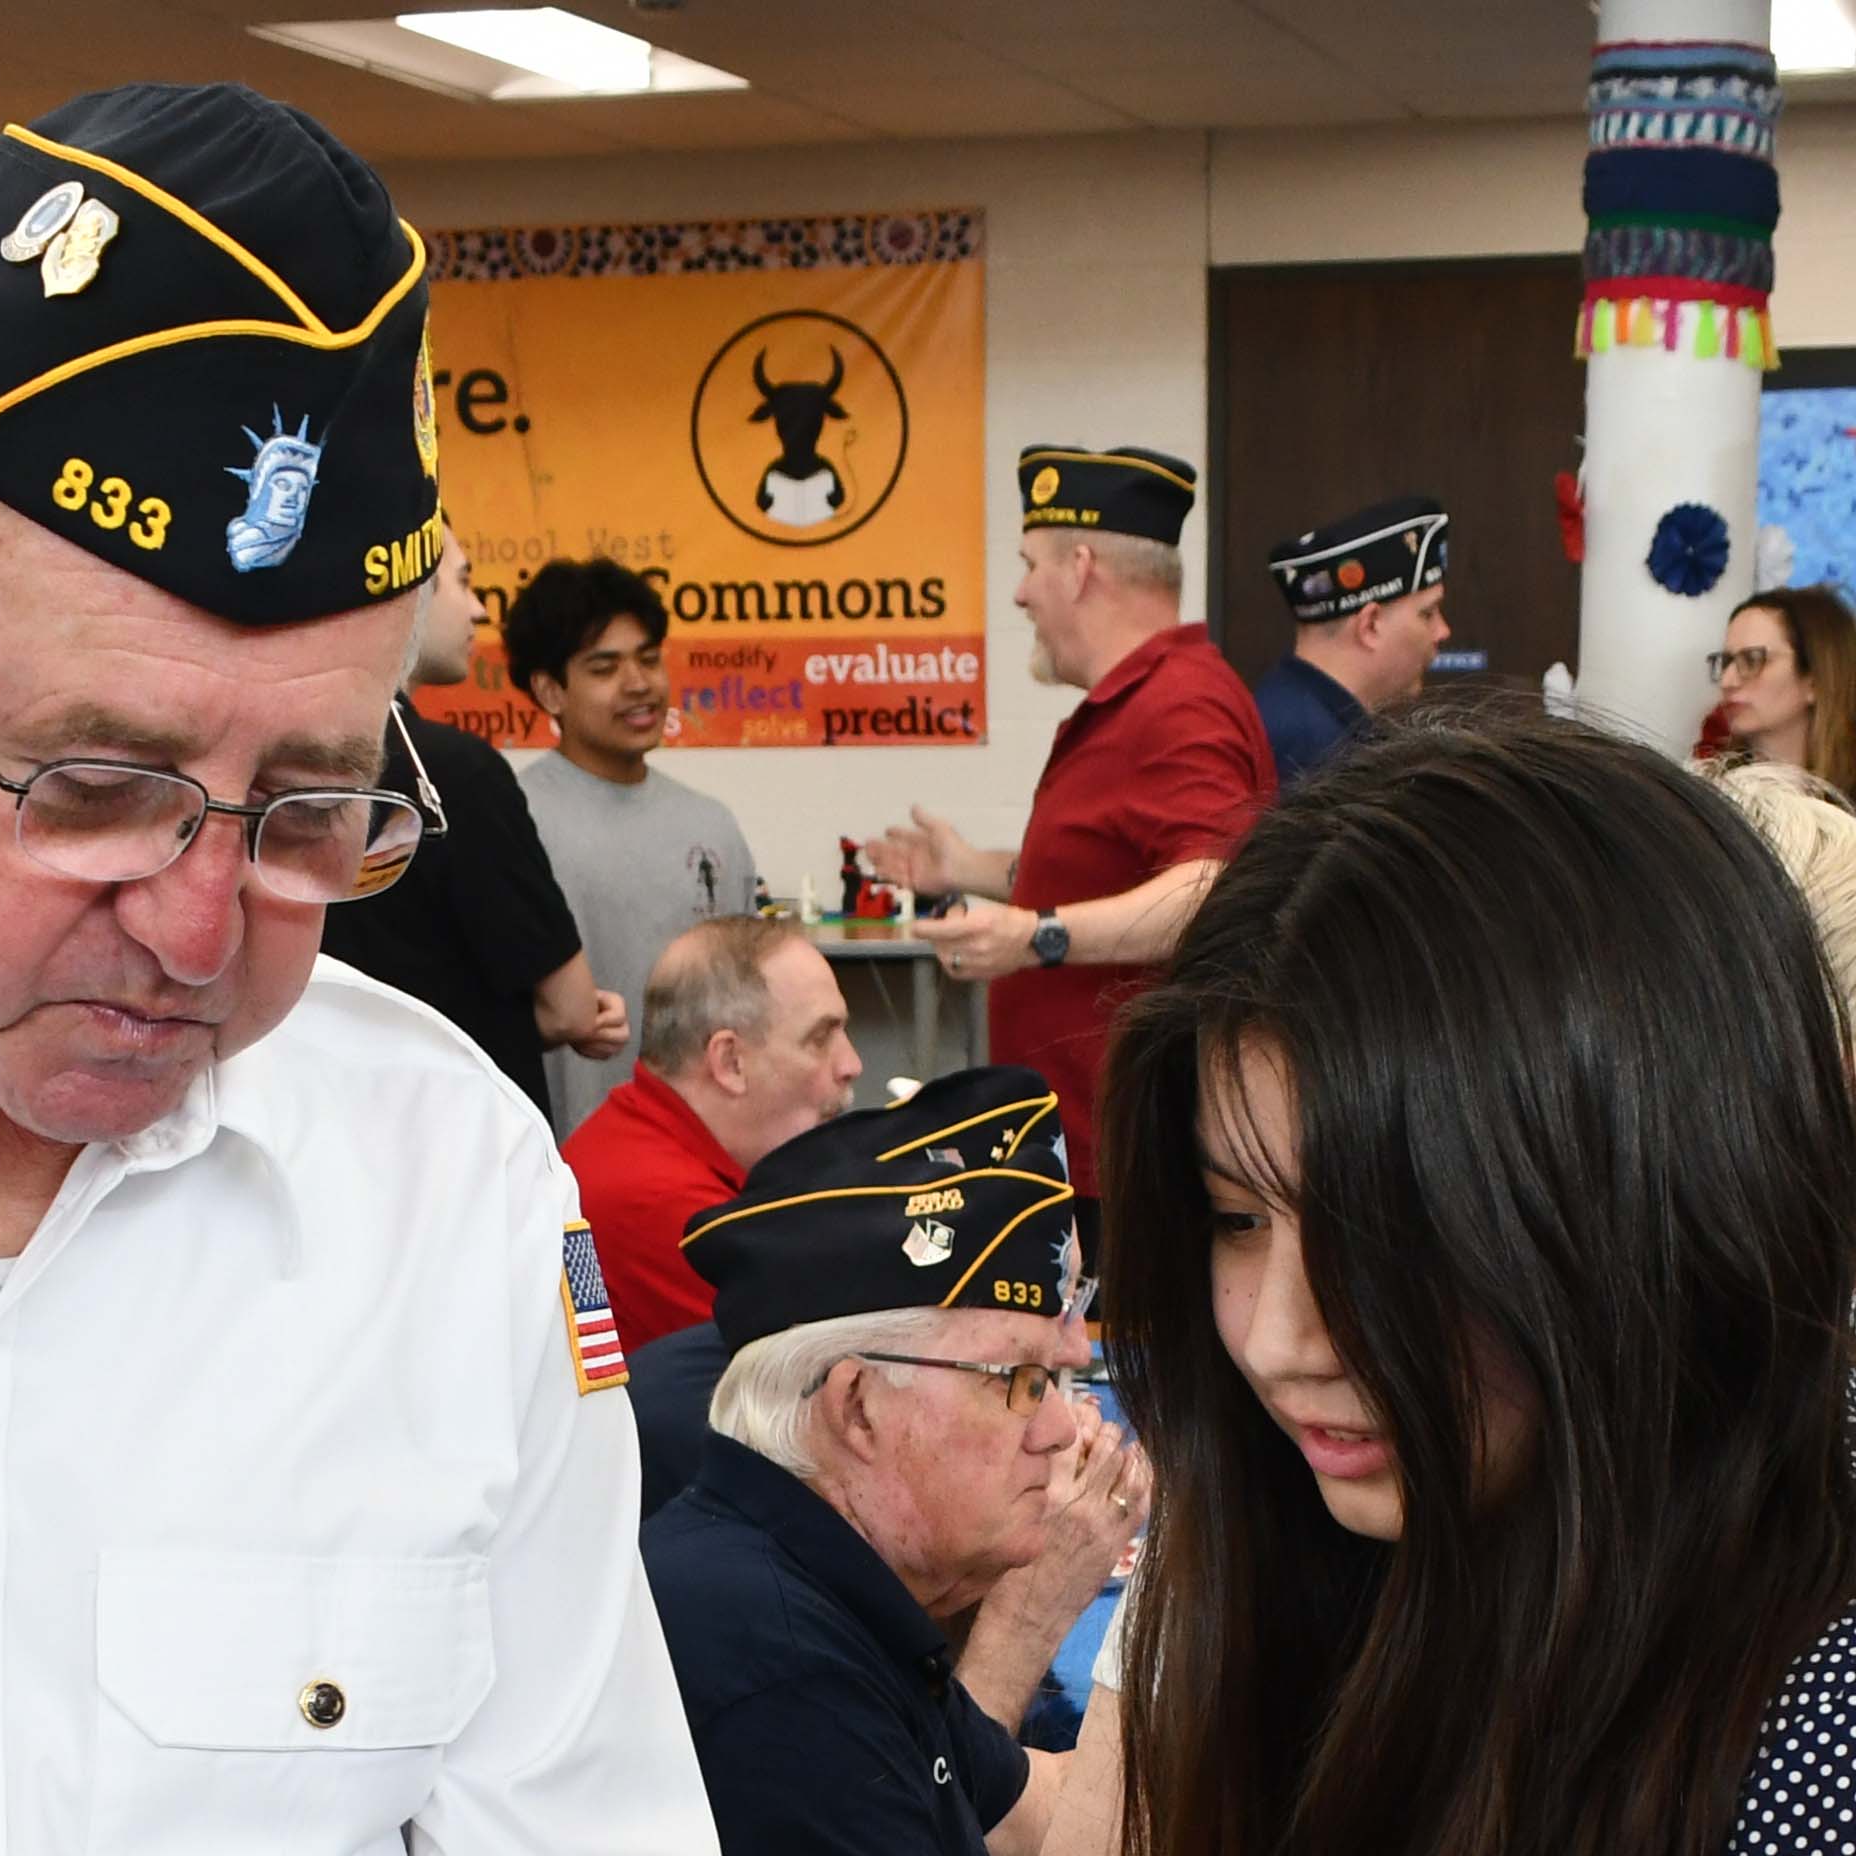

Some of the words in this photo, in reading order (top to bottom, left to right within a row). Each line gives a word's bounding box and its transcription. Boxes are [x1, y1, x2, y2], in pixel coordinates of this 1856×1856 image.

[52, 458, 172, 551] 833
[586, 527, 675, 562] West
[689, 645, 777, 672] modify
[804, 643, 979, 685] evaluate
[681, 675, 803, 713] reflect
[445, 702, 538, 738] apply
[822, 696, 975, 745] predict
[994, 1279, 1042, 1308] 833
